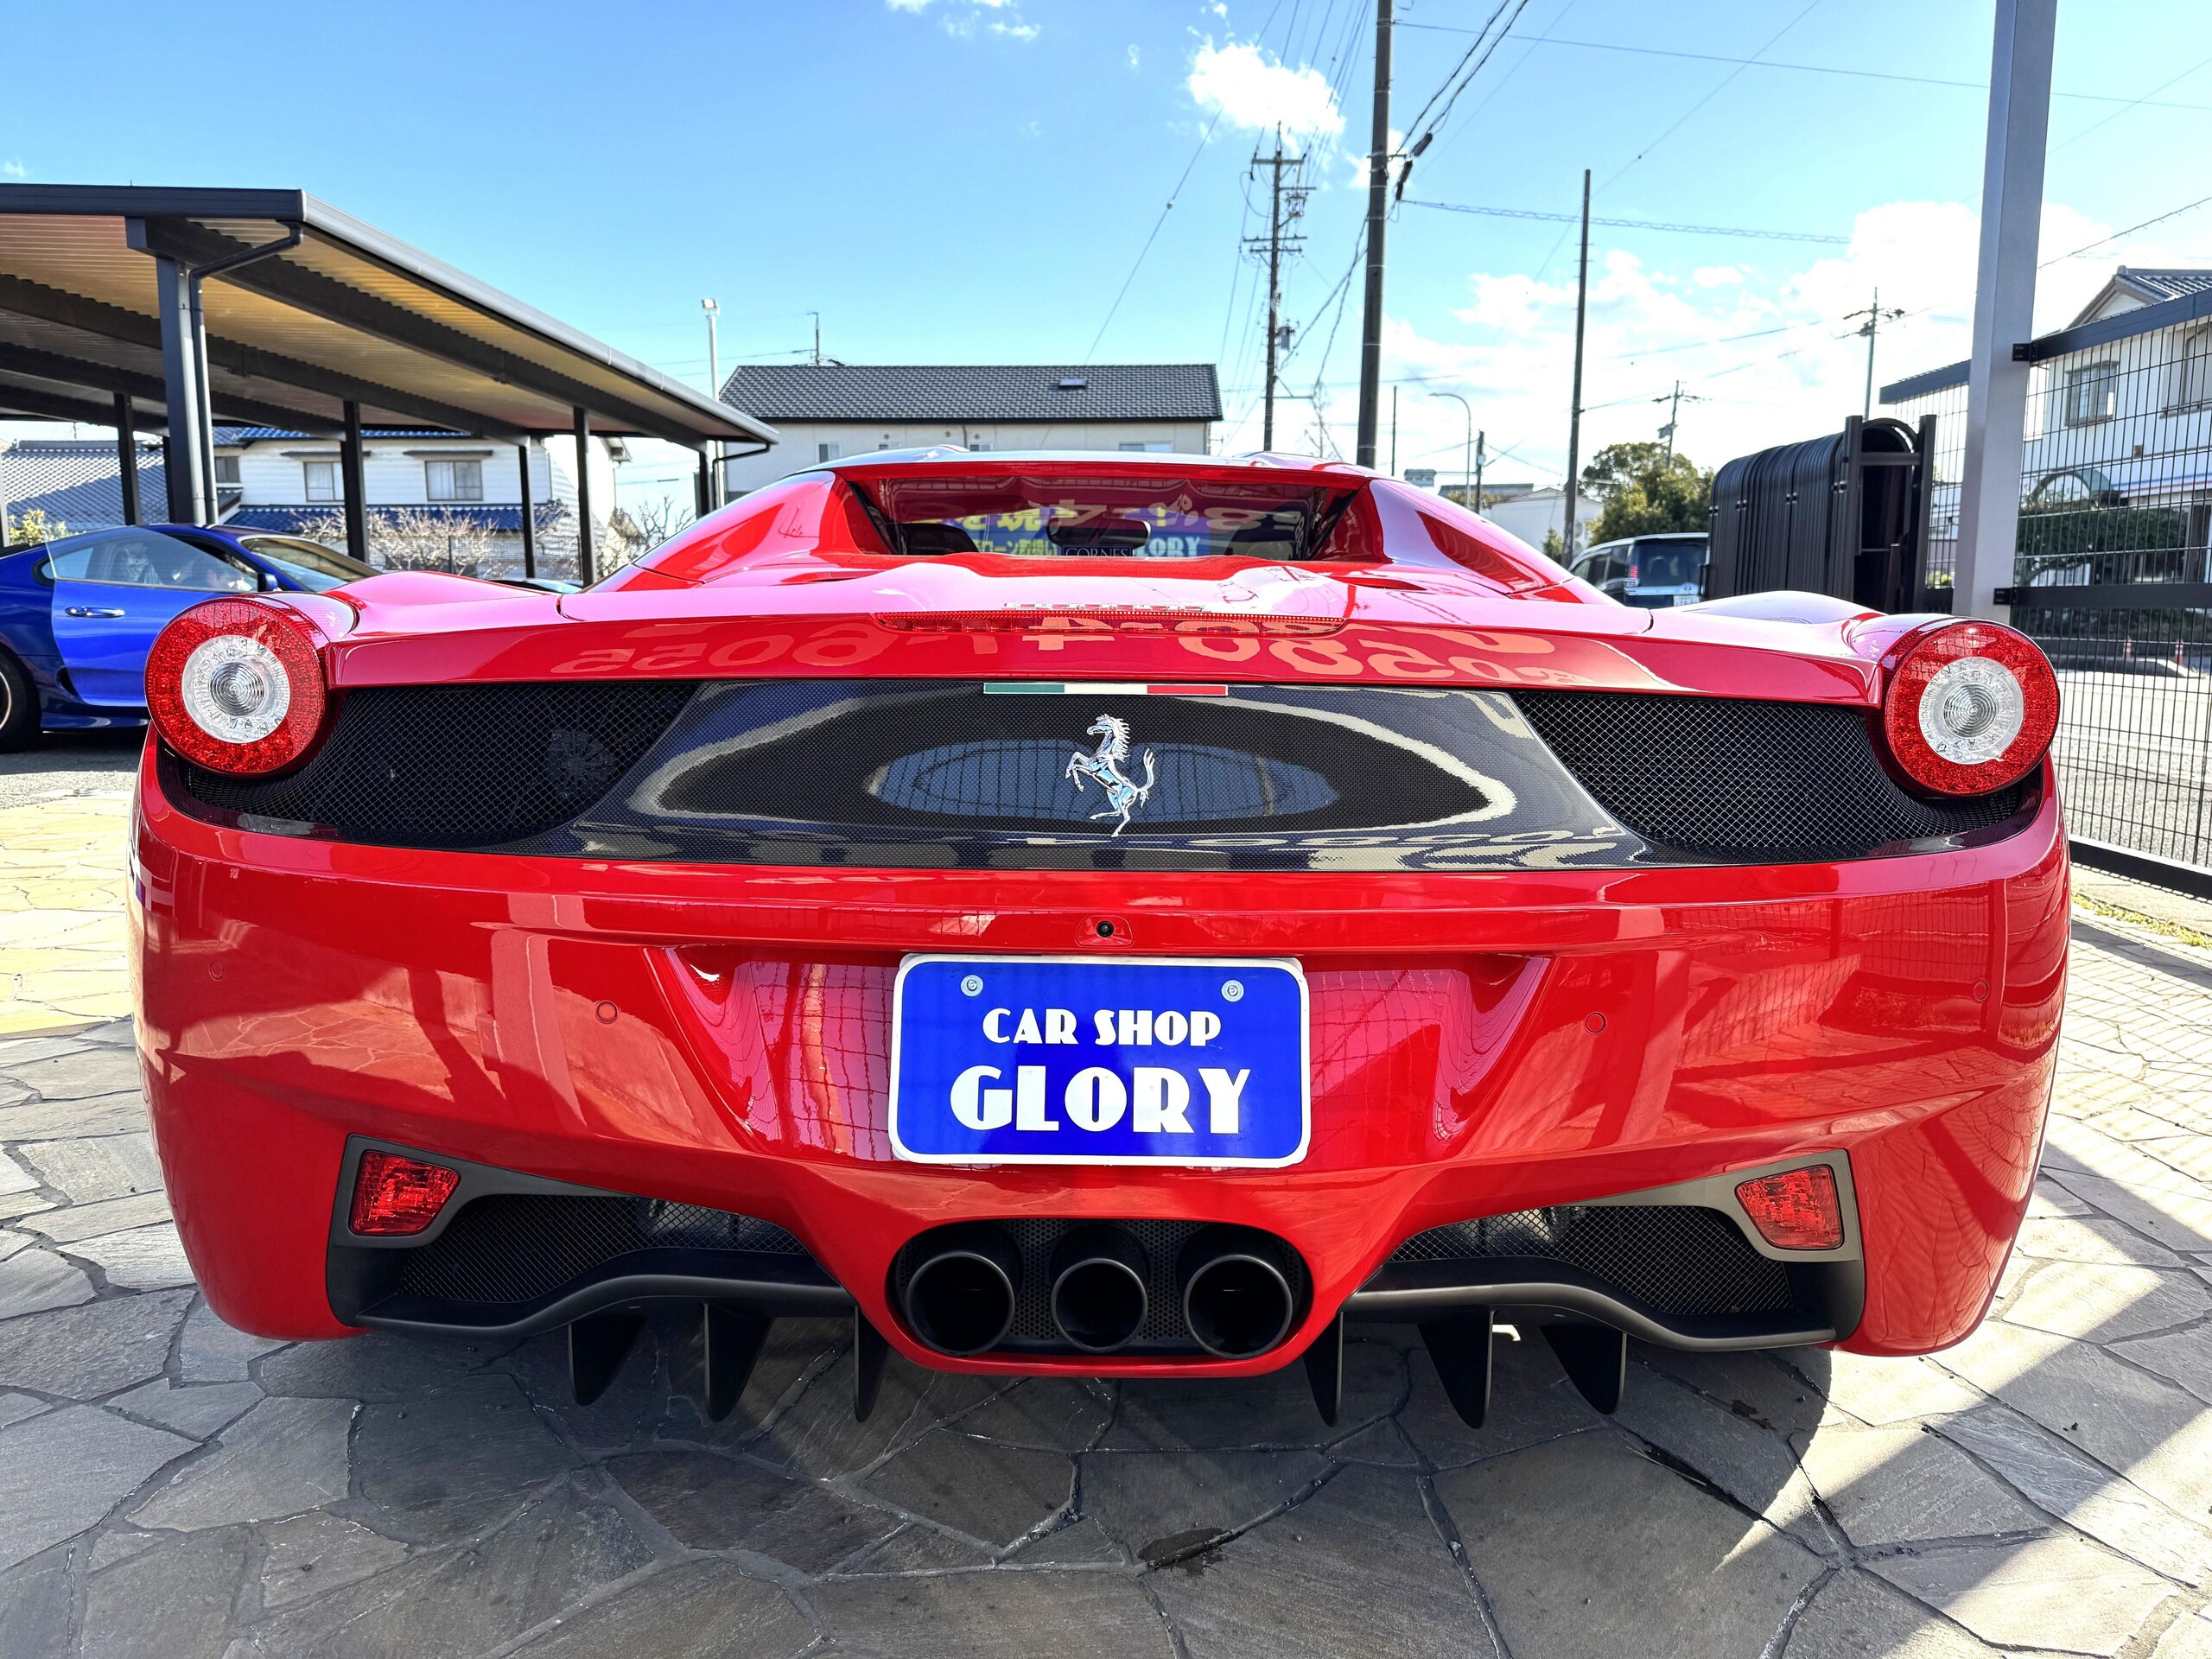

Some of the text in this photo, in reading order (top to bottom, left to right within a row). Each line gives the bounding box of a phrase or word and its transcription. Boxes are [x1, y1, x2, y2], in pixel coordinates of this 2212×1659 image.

[1133, 537, 1200, 557] LORY
[982, 1007, 1222, 1046] CAR SHOP
[949, 1065, 1251, 1135] GLORY
